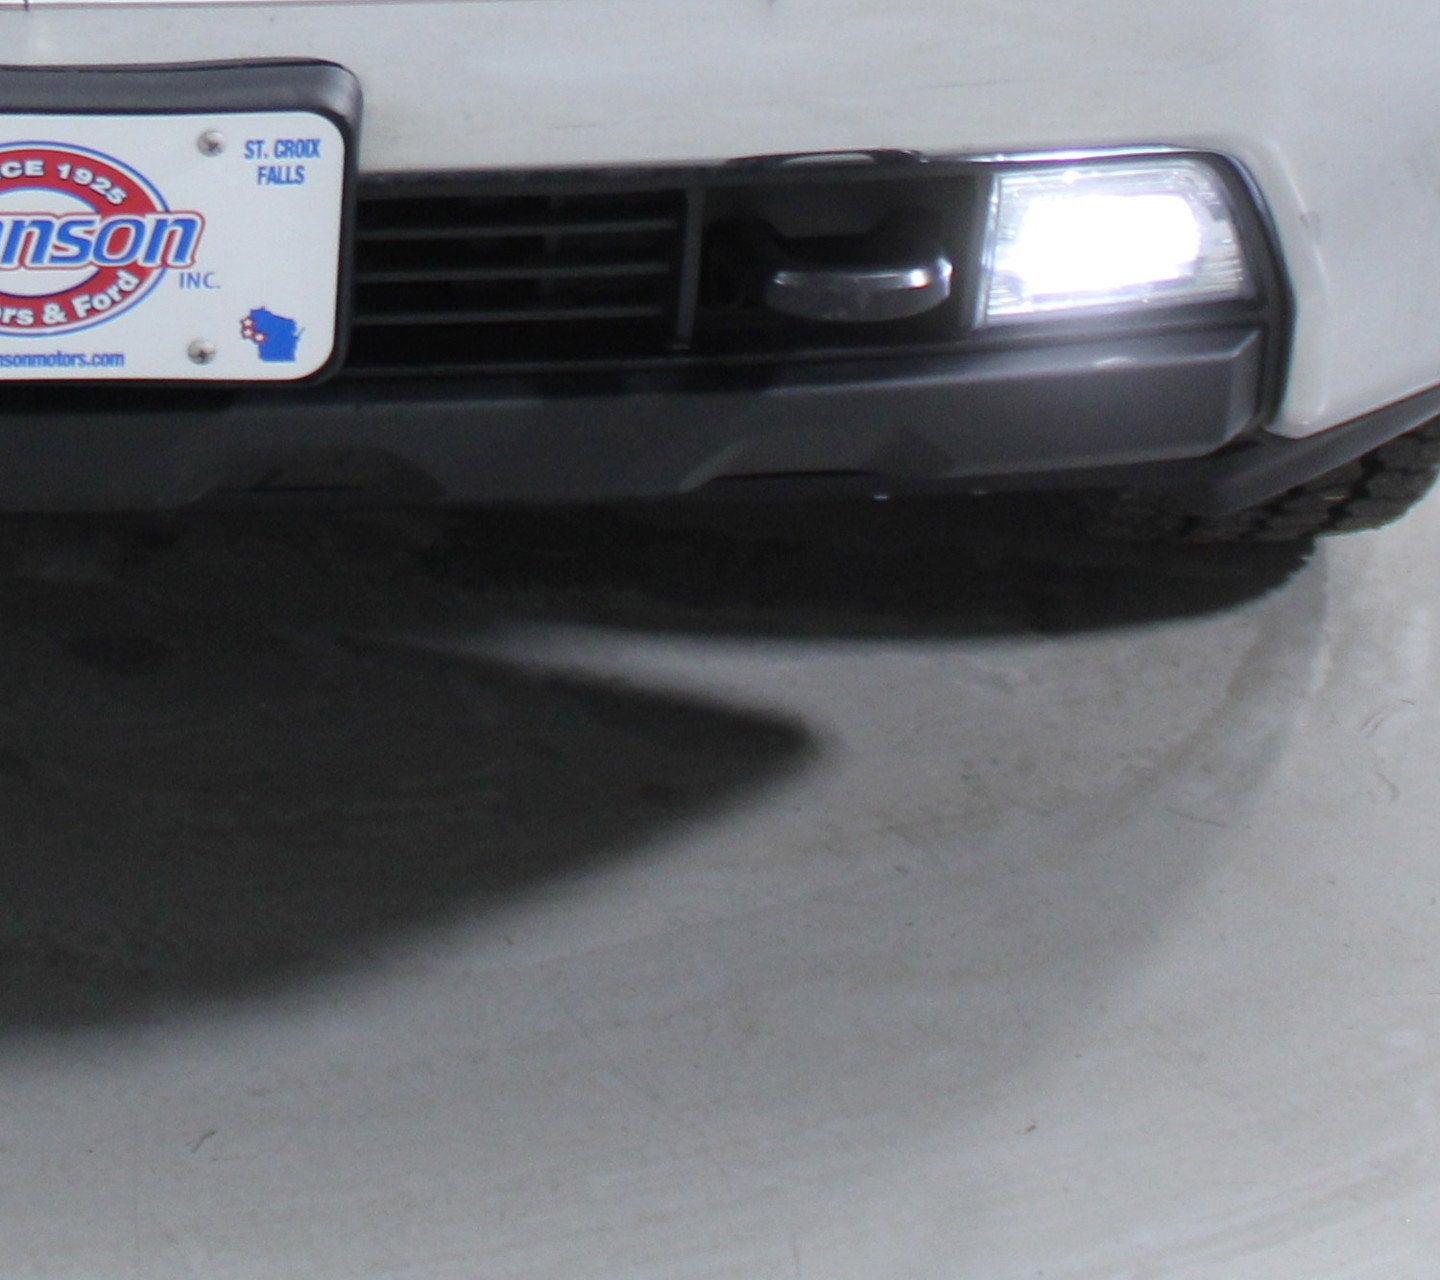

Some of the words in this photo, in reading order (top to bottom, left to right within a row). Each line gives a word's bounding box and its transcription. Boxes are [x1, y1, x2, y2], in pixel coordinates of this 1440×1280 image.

[244, 140, 268, 159] ST.
[274, 138, 320, 159] CROIX
[56, 162, 128, 206] 1925
[257, 165, 305, 185] FALLS
[42, 302, 68, 325] &
[71, 269, 140, 320] Ford
